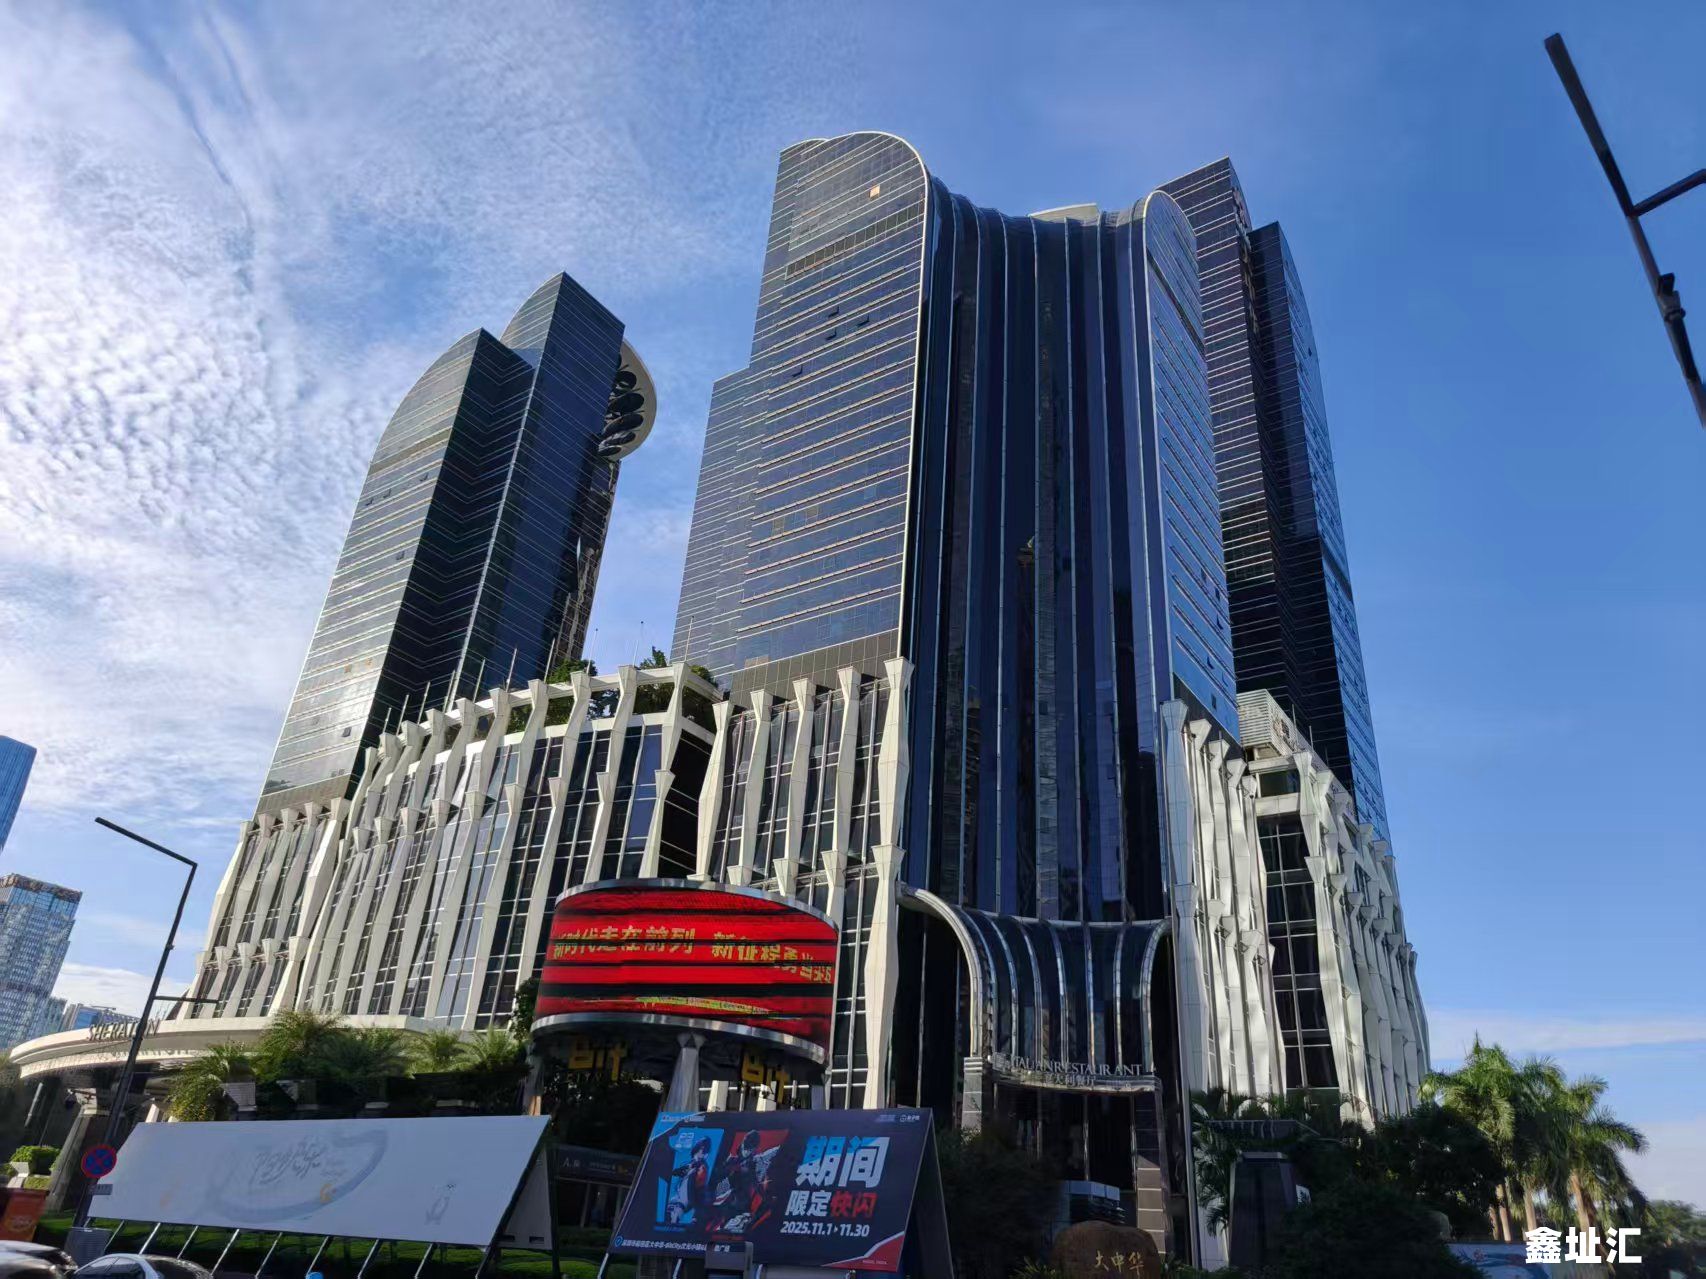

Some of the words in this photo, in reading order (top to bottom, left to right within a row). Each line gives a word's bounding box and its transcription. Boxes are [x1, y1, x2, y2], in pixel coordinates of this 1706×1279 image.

[88, 1018, 161, 1042] SHERATN
[795, 1136, 890, 1188] 期间
[784, 1189, 878, 1218] 限定快闪
[780, 1221, 831, 1236] 2025.11.1
